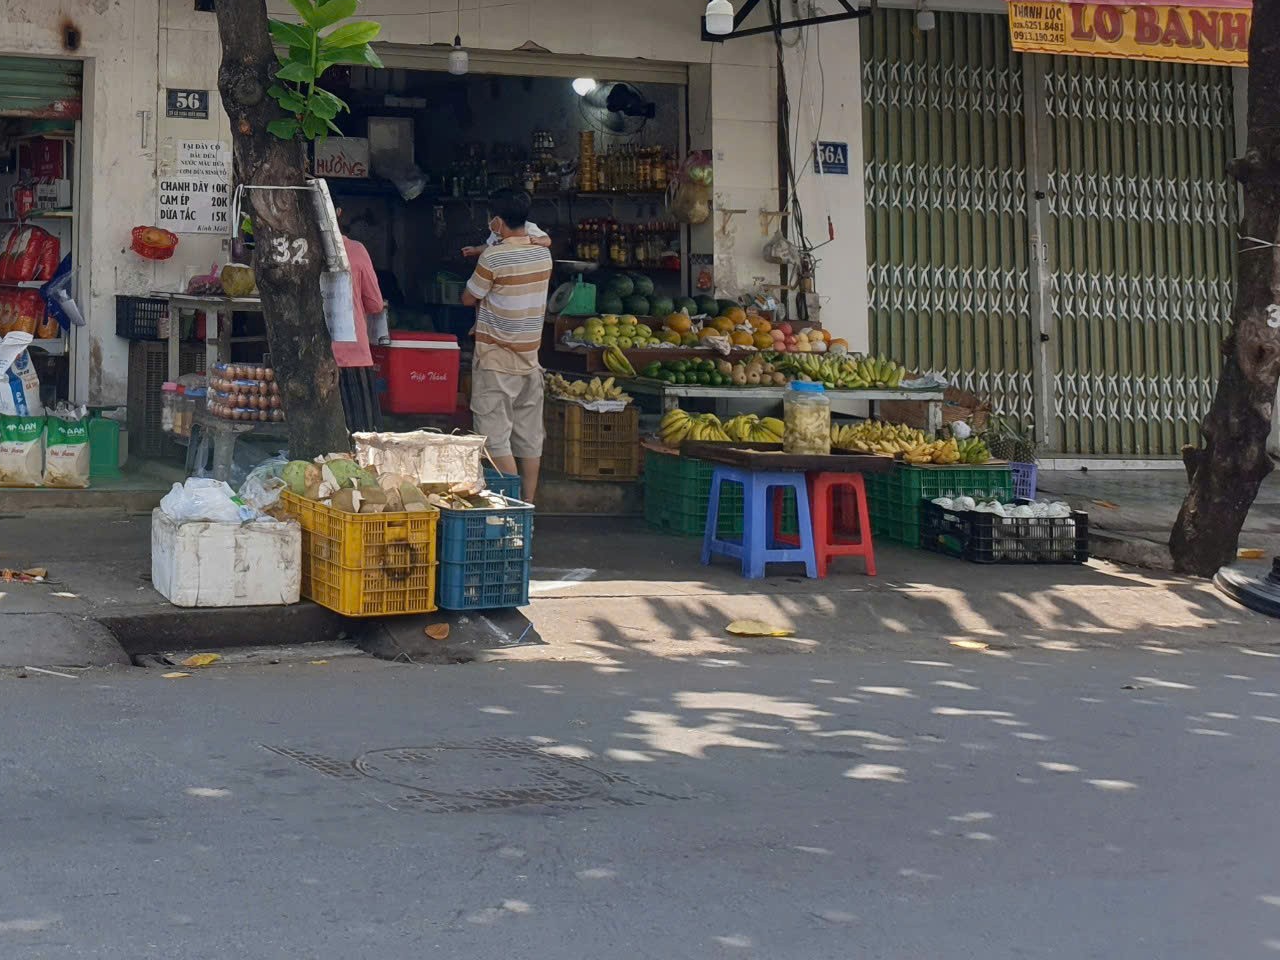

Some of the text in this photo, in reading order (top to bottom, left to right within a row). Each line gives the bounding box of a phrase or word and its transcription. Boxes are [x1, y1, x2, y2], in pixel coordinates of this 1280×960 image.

[176, 92, 200, 110] 56
[816, 145, 845, 164] 56A
[160, 181, 190, 192] CHANH
[212, 183, 228, 194] 10K
[160, 192, 228, 208] CAM ÉP 20K
[160, 207, 178, 220] DỪA
[211, 211, 227, 222] 15K
[272, 237, 310, 265] 32
[18, 422, 37, 432] AAN
